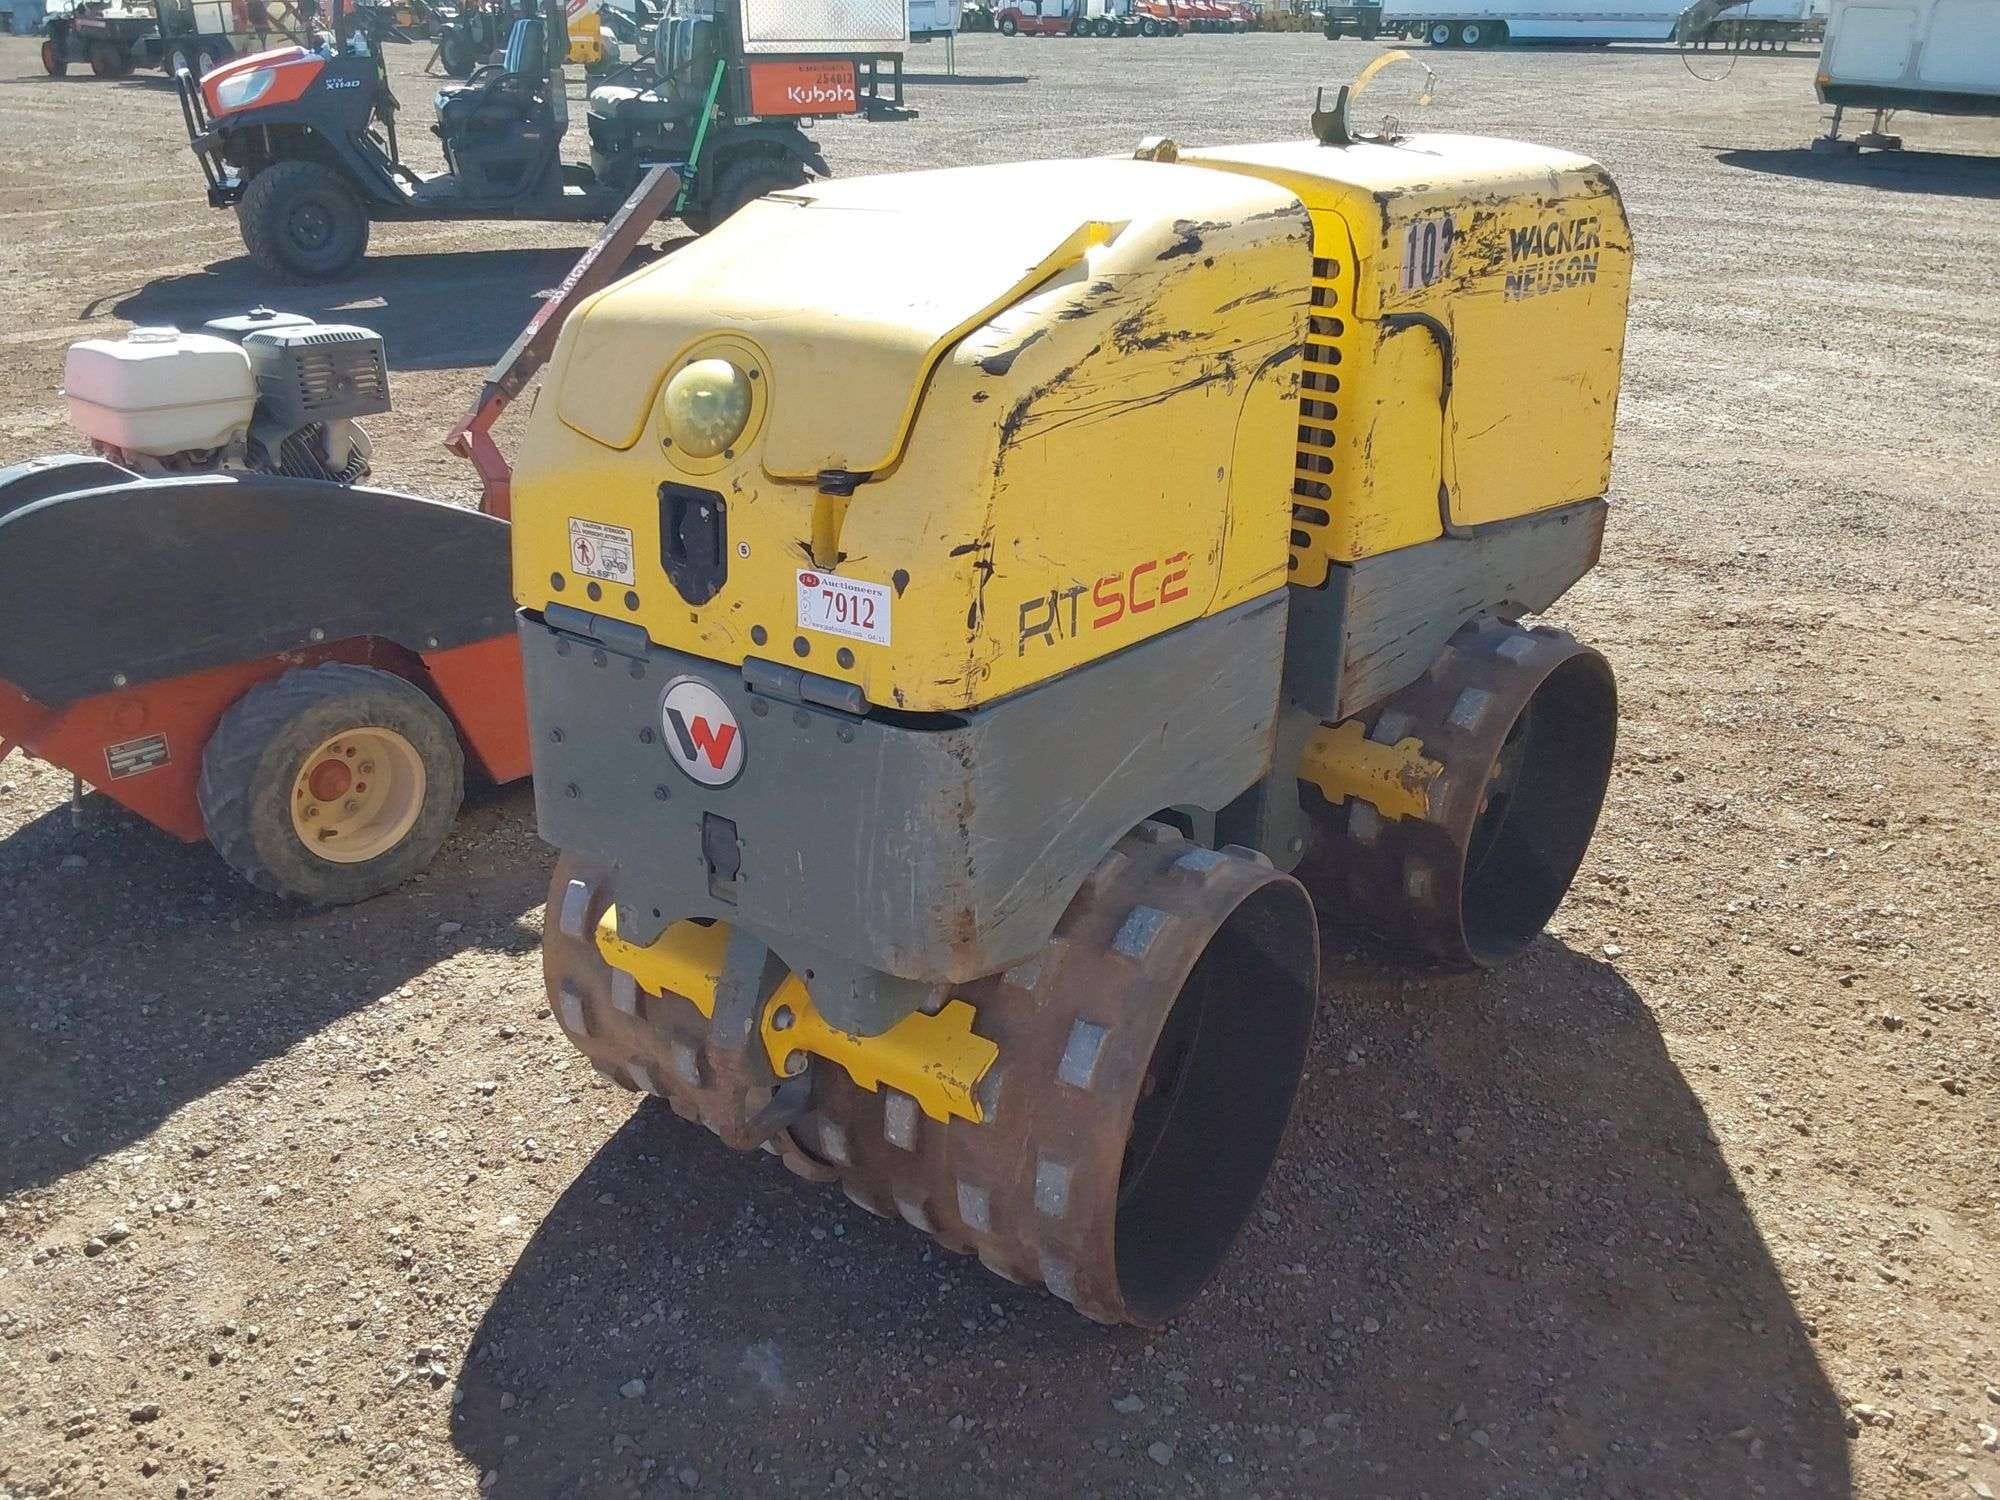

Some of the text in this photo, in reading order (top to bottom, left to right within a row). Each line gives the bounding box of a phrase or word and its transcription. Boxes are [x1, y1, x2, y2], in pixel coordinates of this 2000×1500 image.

[787, 84, 855, 104] Kubota
[1504, 252, 1600, 304] NEUSON
[821, 579, 883, 597] Auctioneers
[822, 590, 875, 629] 7912
